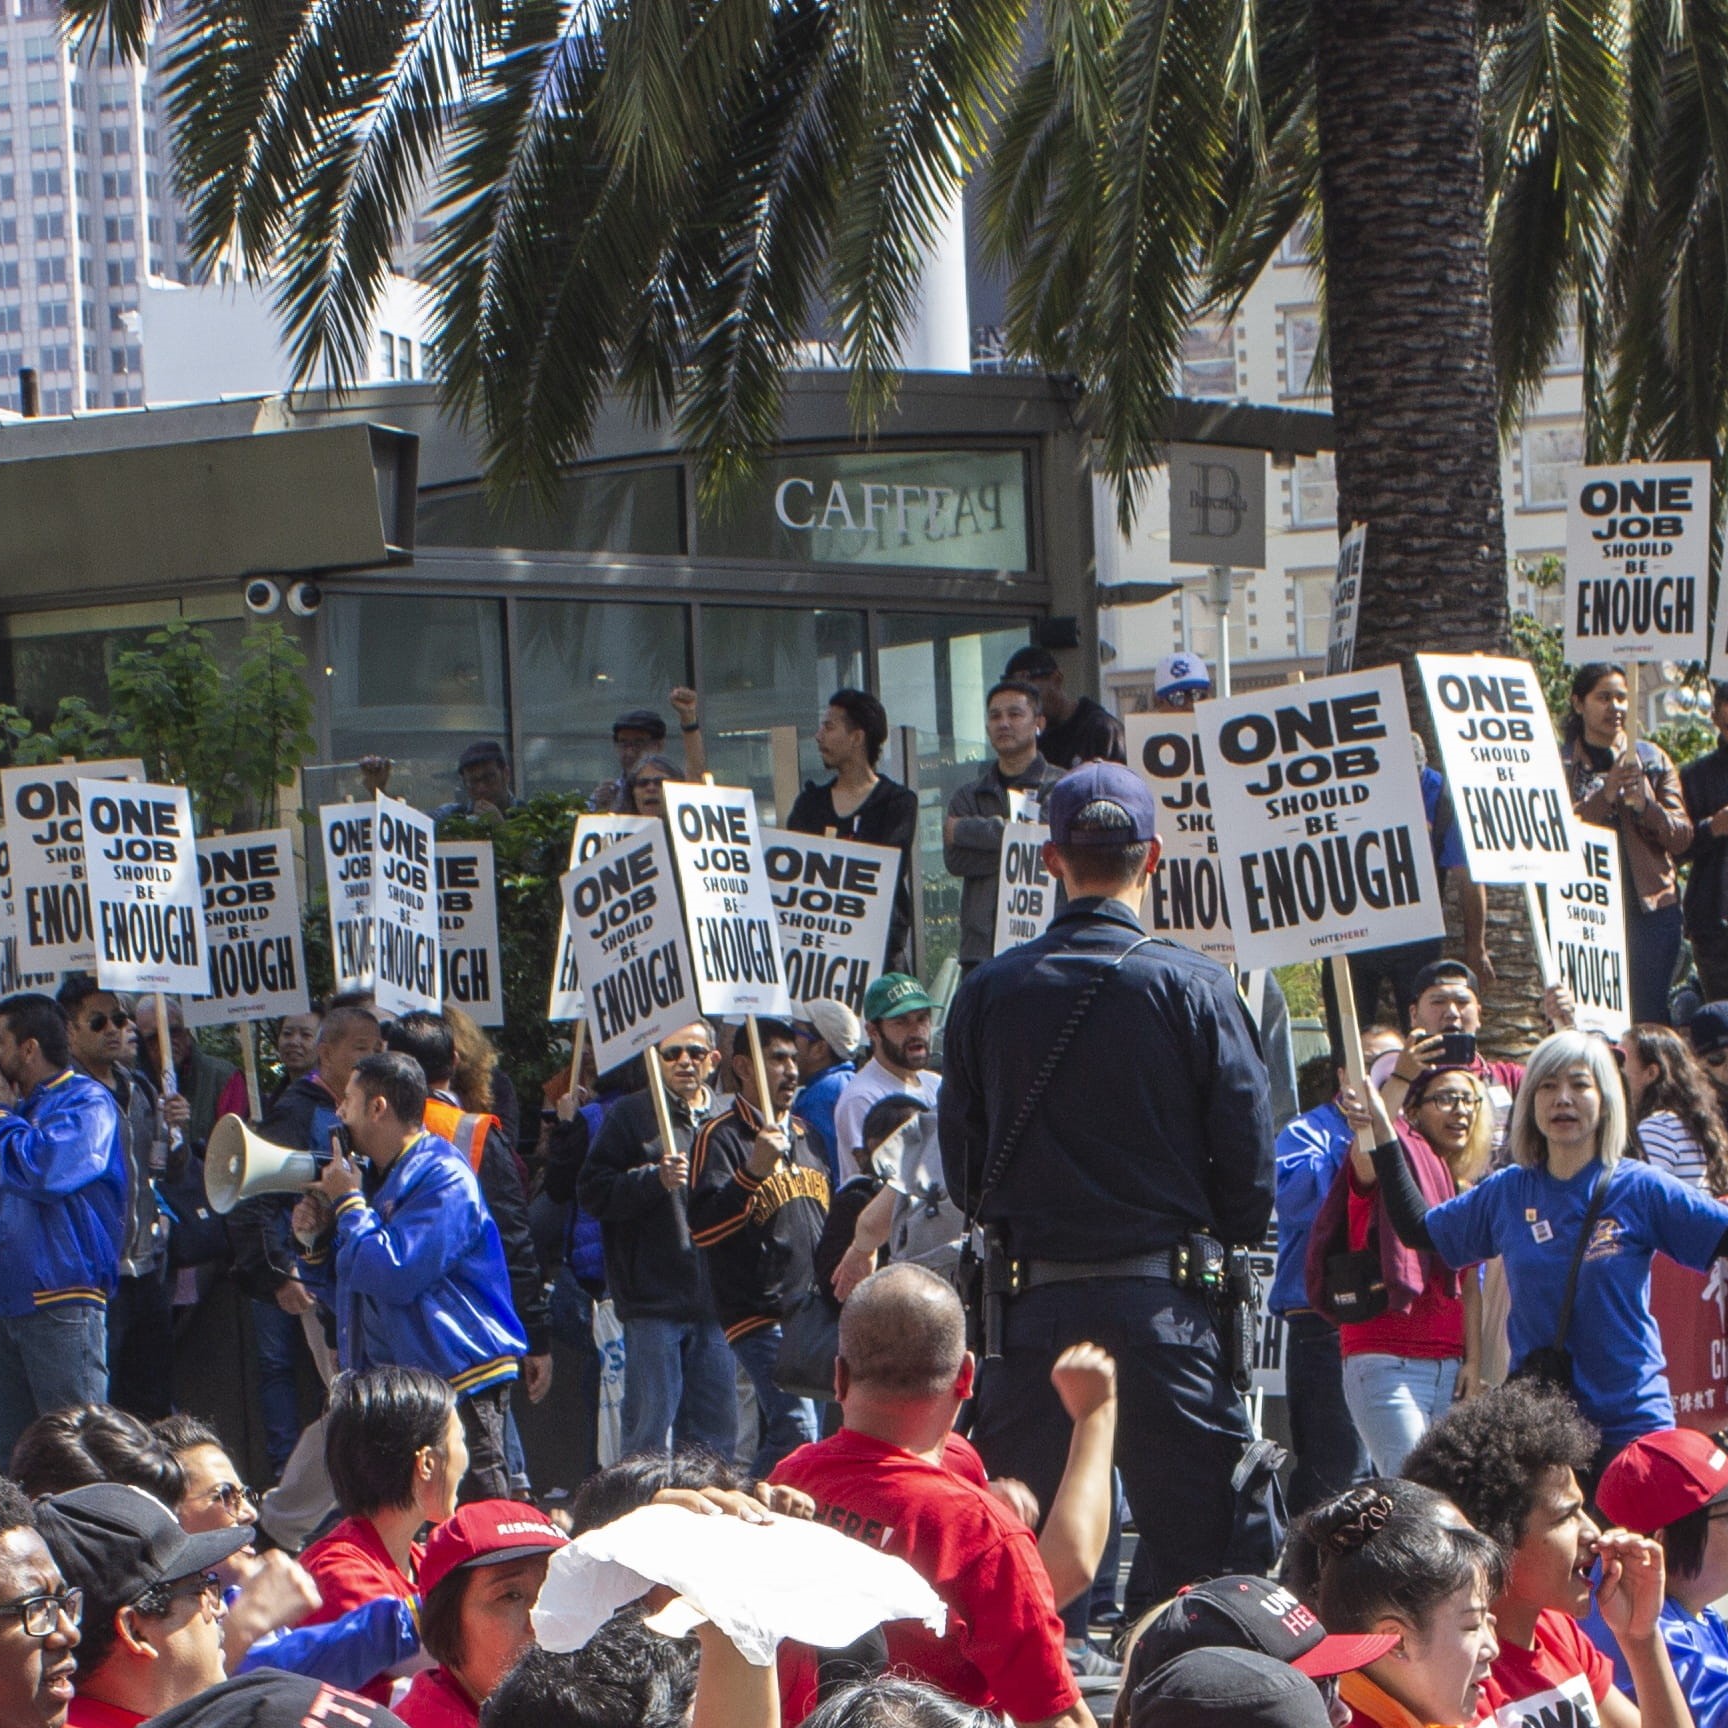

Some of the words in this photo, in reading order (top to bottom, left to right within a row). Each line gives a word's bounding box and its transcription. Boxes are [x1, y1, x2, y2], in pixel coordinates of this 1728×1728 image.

[1580, 477, 1693, 516] ONE
[1591, 515, 1684, 541] JOB
[1602, 542, 1673, 559] SHOULD
[1625, 560, 1648, 575] BE
[1576, 576, 1695, 637] ENOUGH
[1437, 674, 1534, 714] ONE
[1218, 691, 1386, 765] ONE
[1458, 717, 1534, 742] JOB
[1246, 745, 1380, 797] JOB
[1470, 746, 1530, 765] SHOULD
[1496, 766, 1515, 783] BE
[90, 796, 181, 838] ONE
[1266, 784, 1370, 820] SHOULD
[678, 803, 751, 846] ONE
[1305, 811, 1339, 836] BE
[1462, 786, 1570, 854] ENOUGH
[103, 838, 177, 863] JOB
[379, 812, 430, 868] ONE
[113, 864, 173, 882] SHOULD
[382, 860, 428, 893] JOB
[694, 848, 751, 874] JOB
[766, 847, 879, 897] ONE
[1006, 841, 1049, 887] ONE
[137, 885, 155, 900] BE
[574, 842, 659, 918] ONE
[703, 877, 749, 895] SHOULD
[1240, 825, 1422, 934] ENOUGH
[388, 885, 425, 910] SHOULD
[591, 885, 659, 940] JOB
[724, 898, 741, 914] BE
[773, 887, 866, 920] JOB
[1008, 888, 1043, 917] JOB
[228, 922, 251, 939] BE
[398, 909, 412, 925] BE
[779, 912, 853, 936] SHOULD
[1567, 905, 1607, 927] SHOULD
[100, 900, 198, 967] ENOUGH
[600, 913, 654, 956] SHOULD
[801, 932, 825, 949] BE
[1582, 927, 1596, 942] BE
[379, 918, 438, 1001] ENOUGH
[620, 940, 639, 963] BE
[697, 916, 779, 986] ENOUGH
[592, 941, 685, 1043] ENOUGH
